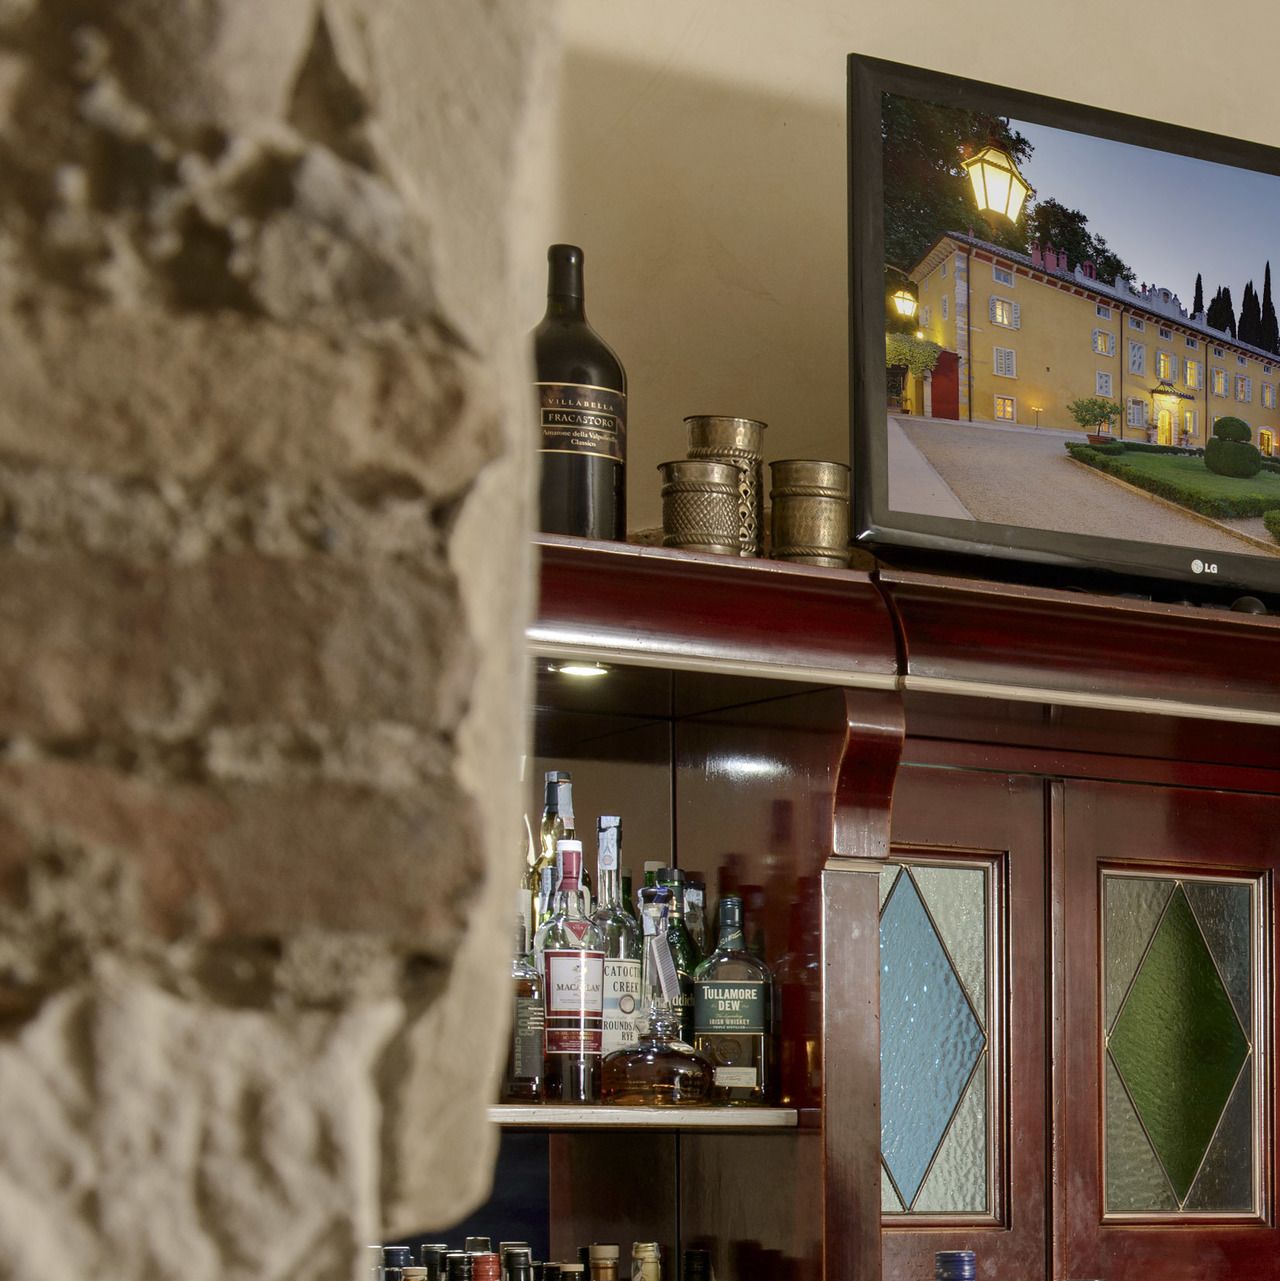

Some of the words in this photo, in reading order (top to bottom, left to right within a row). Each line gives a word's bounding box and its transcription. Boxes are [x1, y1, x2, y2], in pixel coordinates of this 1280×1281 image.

[548, 398, 614, 412] VILLABELLA
[548, 413, 614, 428] FRACASTORO
[702, 986, 758, 1000] TULLAMORE
[718, 1000, 741, 1011] DEW
[621, 1031, 634, 1041] RYE
